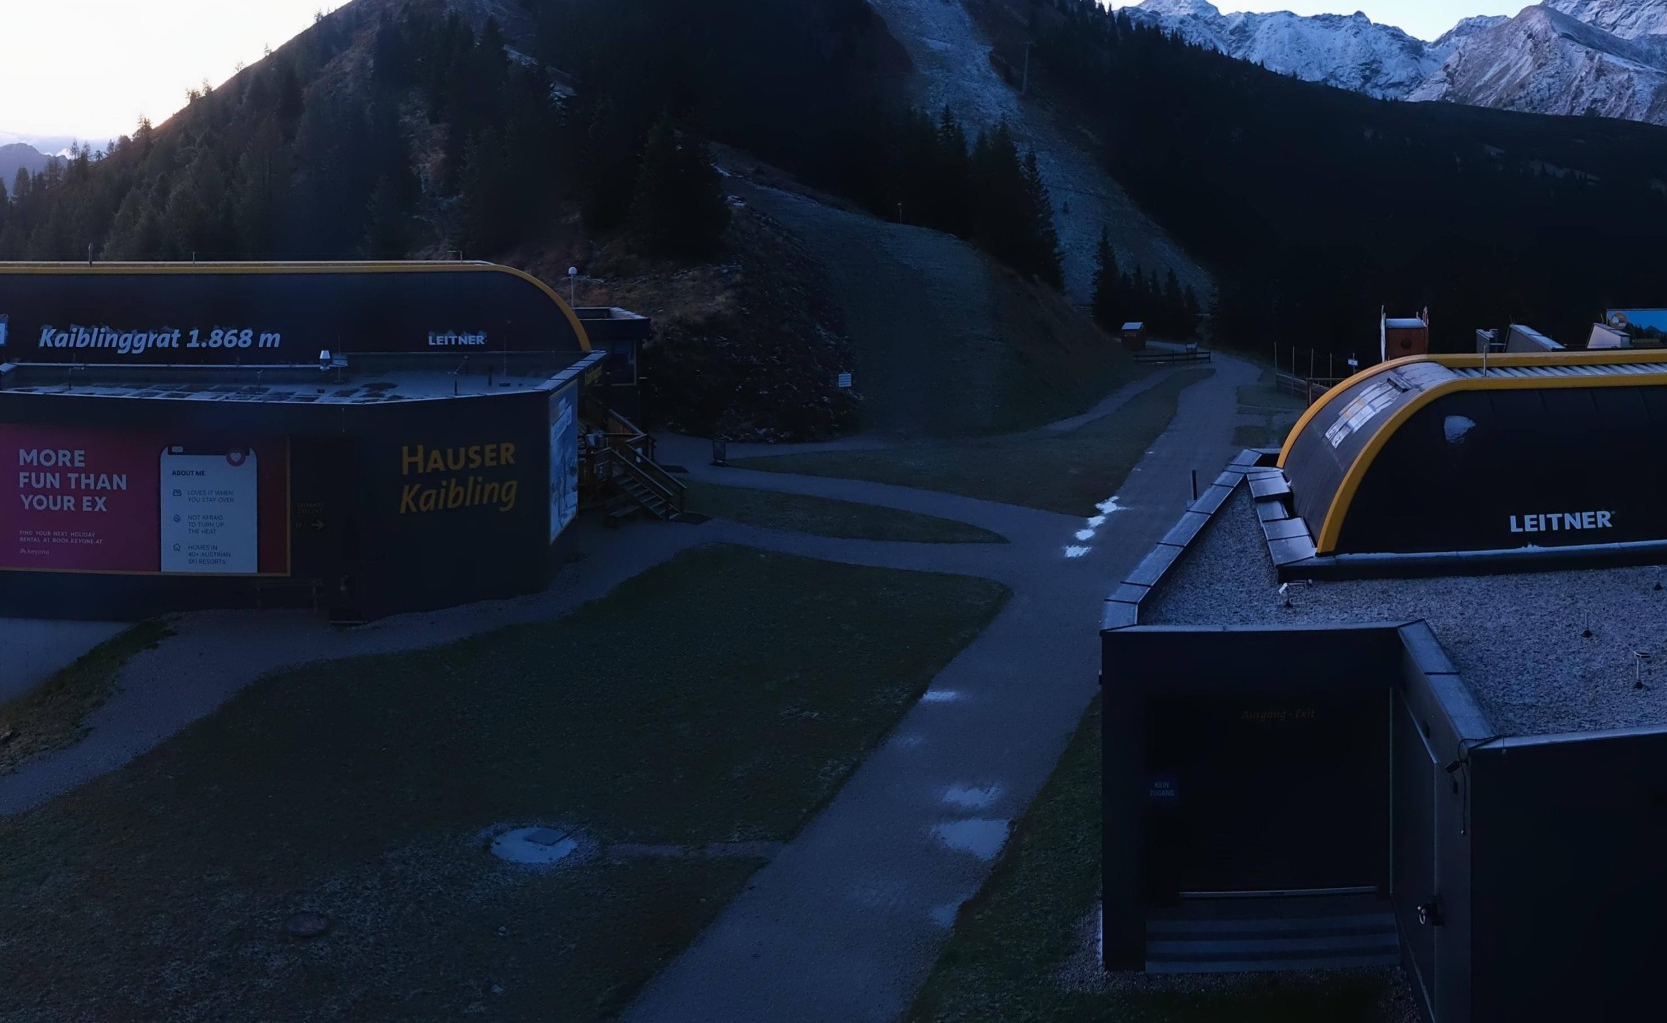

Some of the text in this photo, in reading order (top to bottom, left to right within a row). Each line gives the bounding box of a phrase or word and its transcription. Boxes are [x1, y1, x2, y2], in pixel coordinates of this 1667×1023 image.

[39, 327, 281, 354] Kaiblinggrat 1.868 m
[428, 335, 485, 346] LEITNER
[19, 449, 86, 468] MORE
[402, 442, 516, 475] HAUSER
[19, 472, 127, 490] FUN THAN
[20, 494, 107, 512] YOUR EX
[399, 475, 518, 514] Kaibling
[1510, 510, 1613, 533] LEITNER
